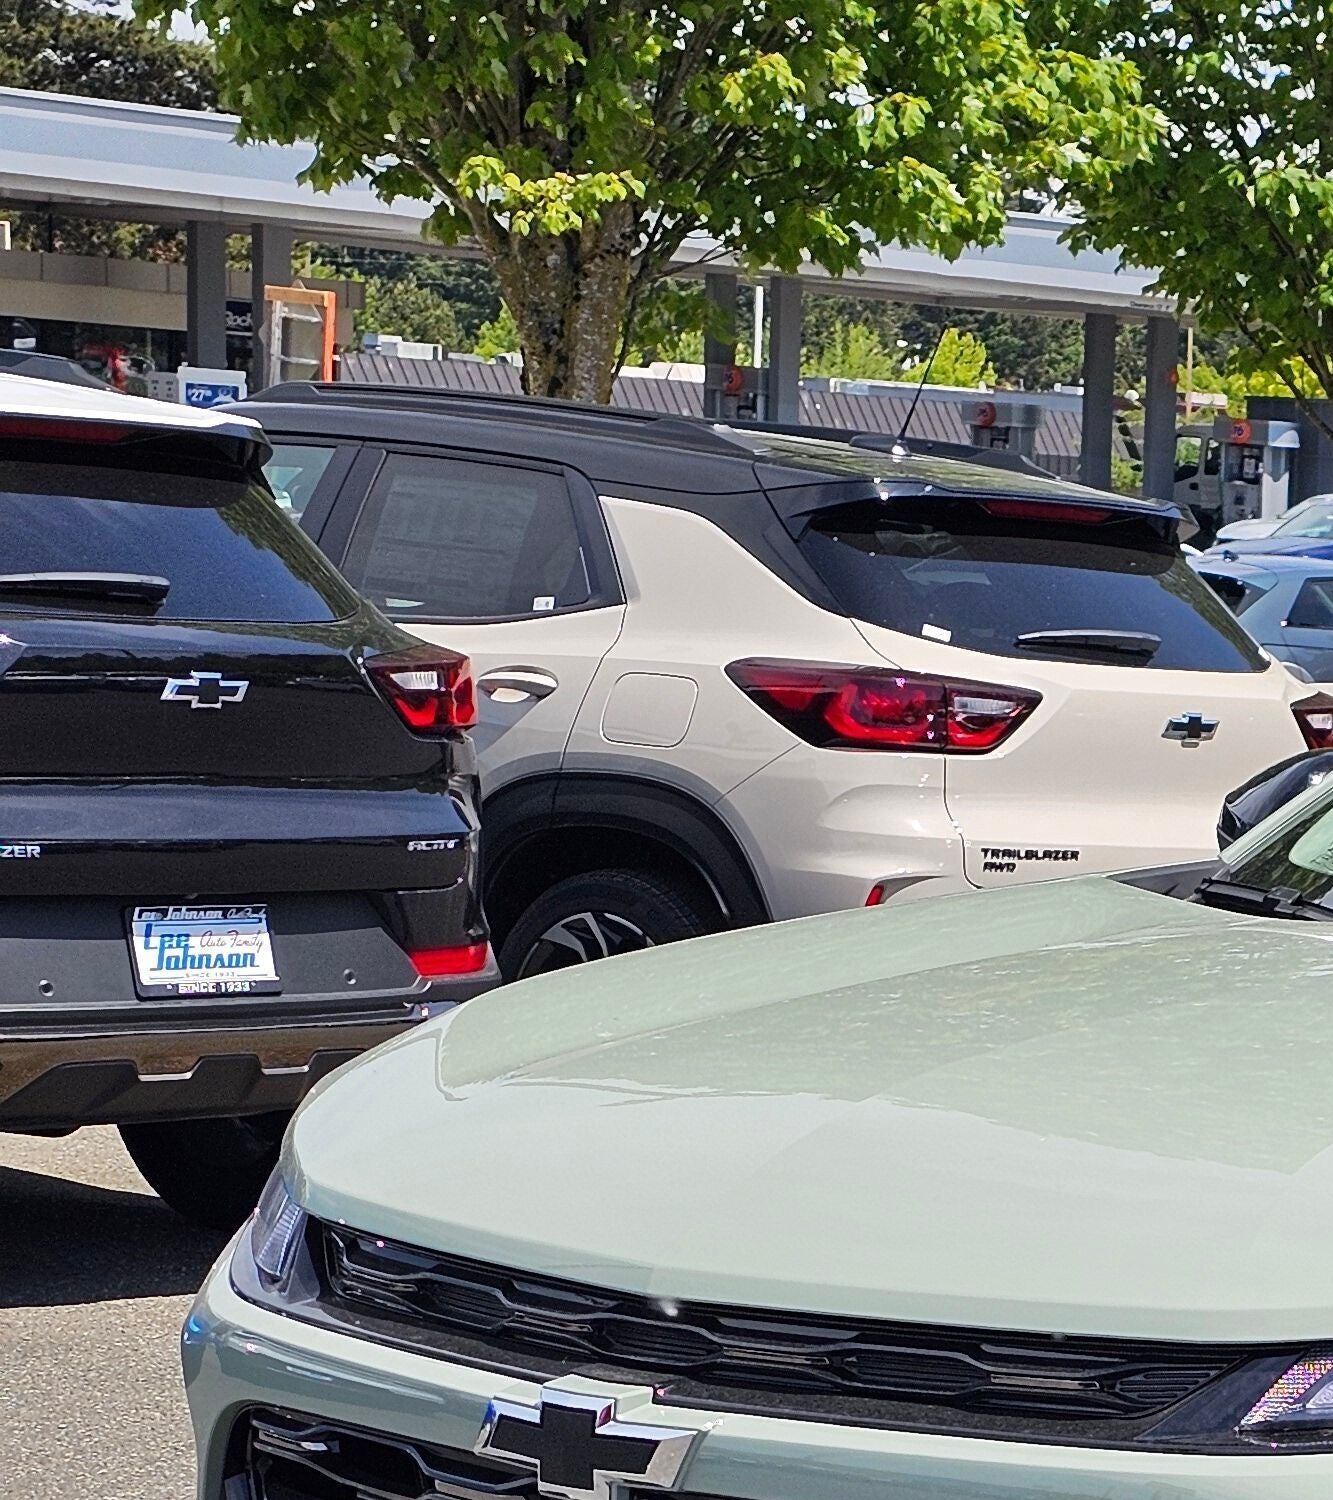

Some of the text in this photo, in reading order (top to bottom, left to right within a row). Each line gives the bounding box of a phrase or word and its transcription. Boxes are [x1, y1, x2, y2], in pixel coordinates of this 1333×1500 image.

[981, 847, 1080, 862] TRAILBLAZER
[144, 923, 195, 950] Lee
[149, 942, 260, 971] Johnson
